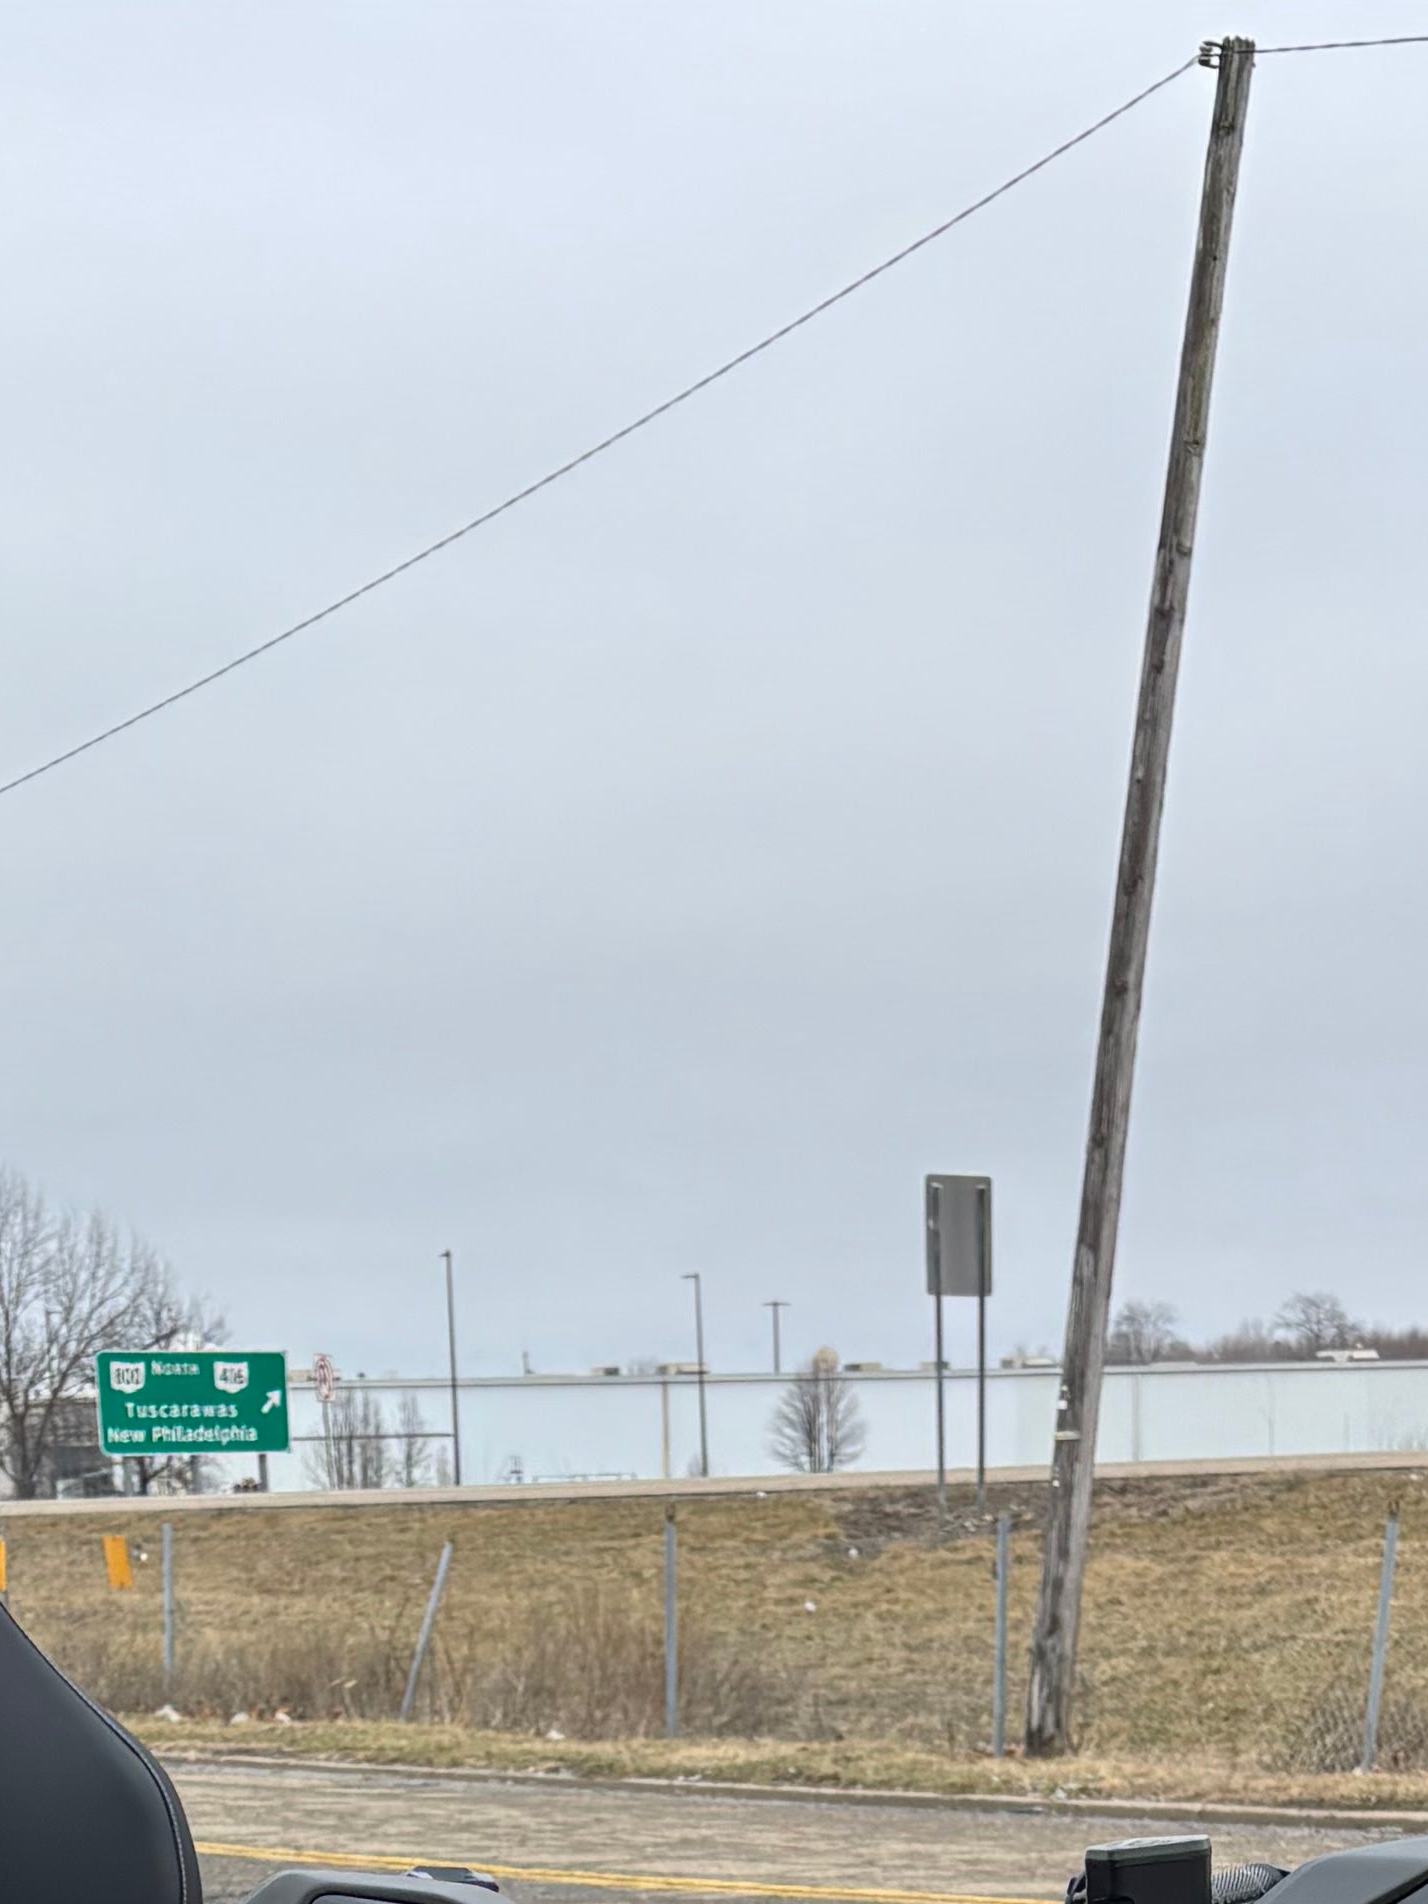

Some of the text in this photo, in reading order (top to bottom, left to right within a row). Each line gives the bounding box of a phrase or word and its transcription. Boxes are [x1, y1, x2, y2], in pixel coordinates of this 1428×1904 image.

[151, 1360, 200, 1375] North
[125, 1402, 238, 1418] Tuscarawas
[107, 1424, 258, 1446] New Philadelphia
